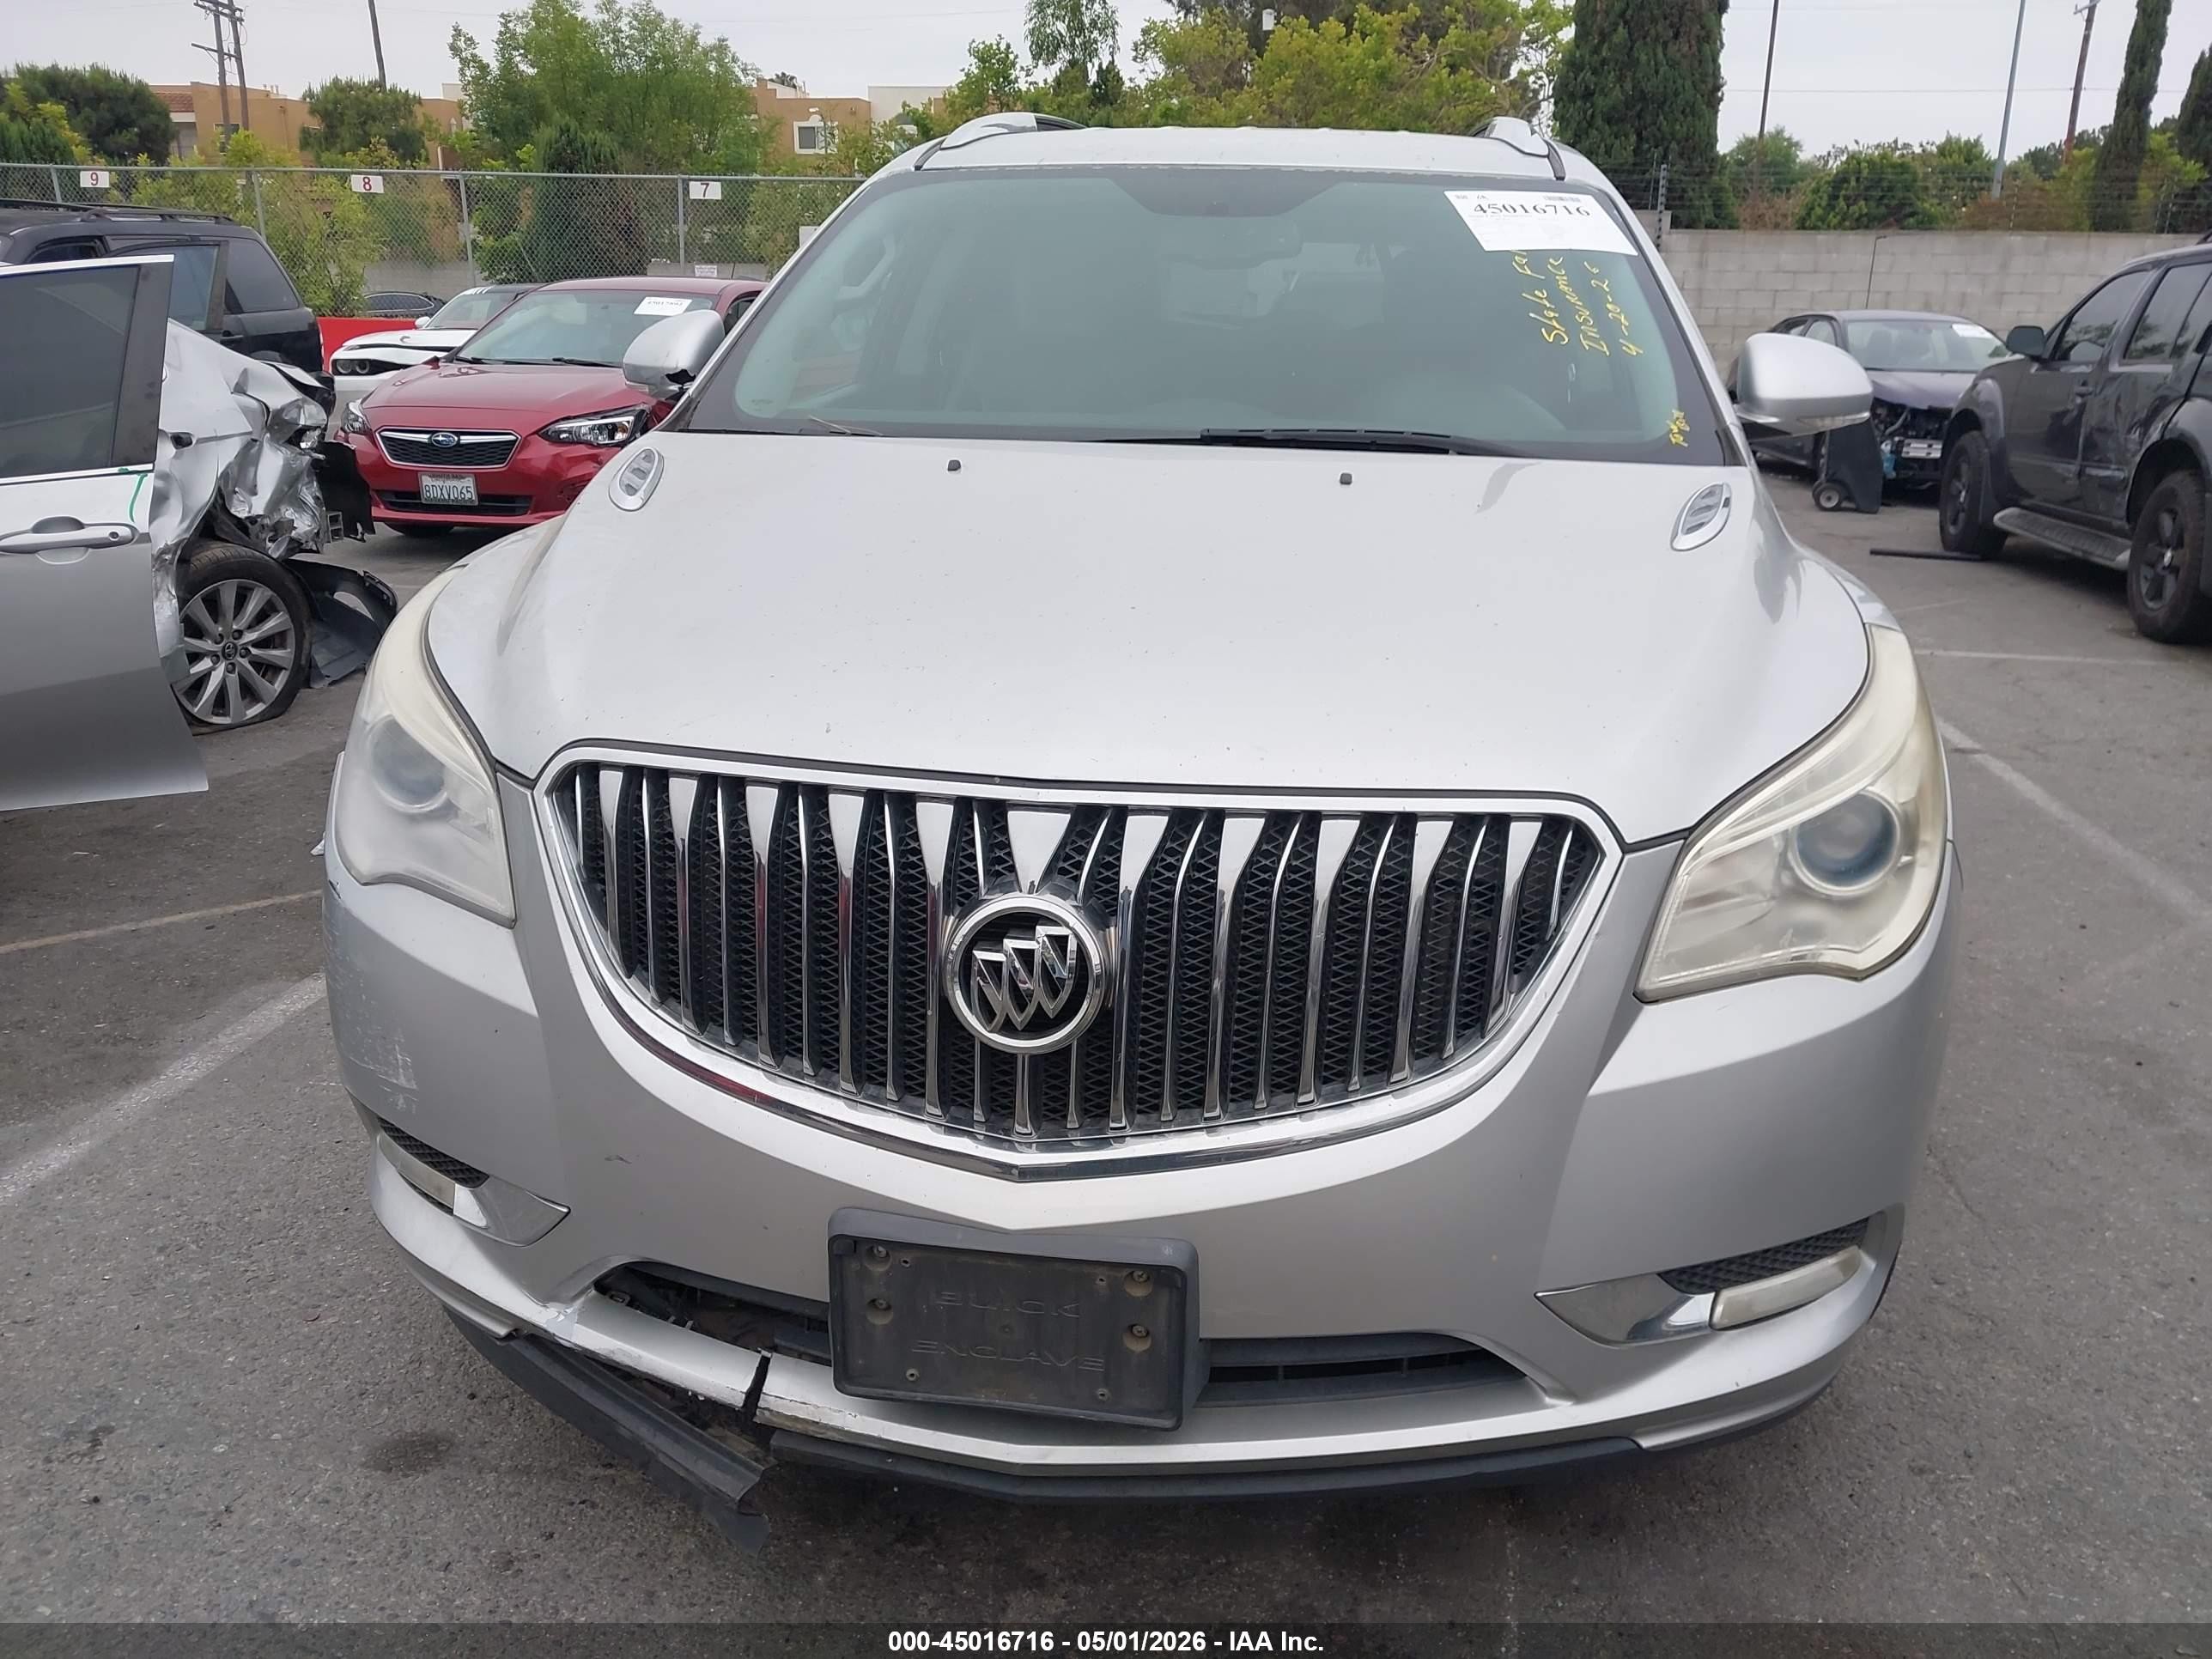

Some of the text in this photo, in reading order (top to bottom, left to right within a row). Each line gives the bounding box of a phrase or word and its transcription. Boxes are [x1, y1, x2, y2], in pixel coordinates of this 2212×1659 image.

[90, 172, 99, 186] 9
[362, 177, 372, 191] 8
[700, 182, 710, 198] 7
[1474, 203, 1591, 216] 45016716
[424, 483, 473, 501] 8DXV065
[911, 1340, 1106, 1372] ENCLAVE
